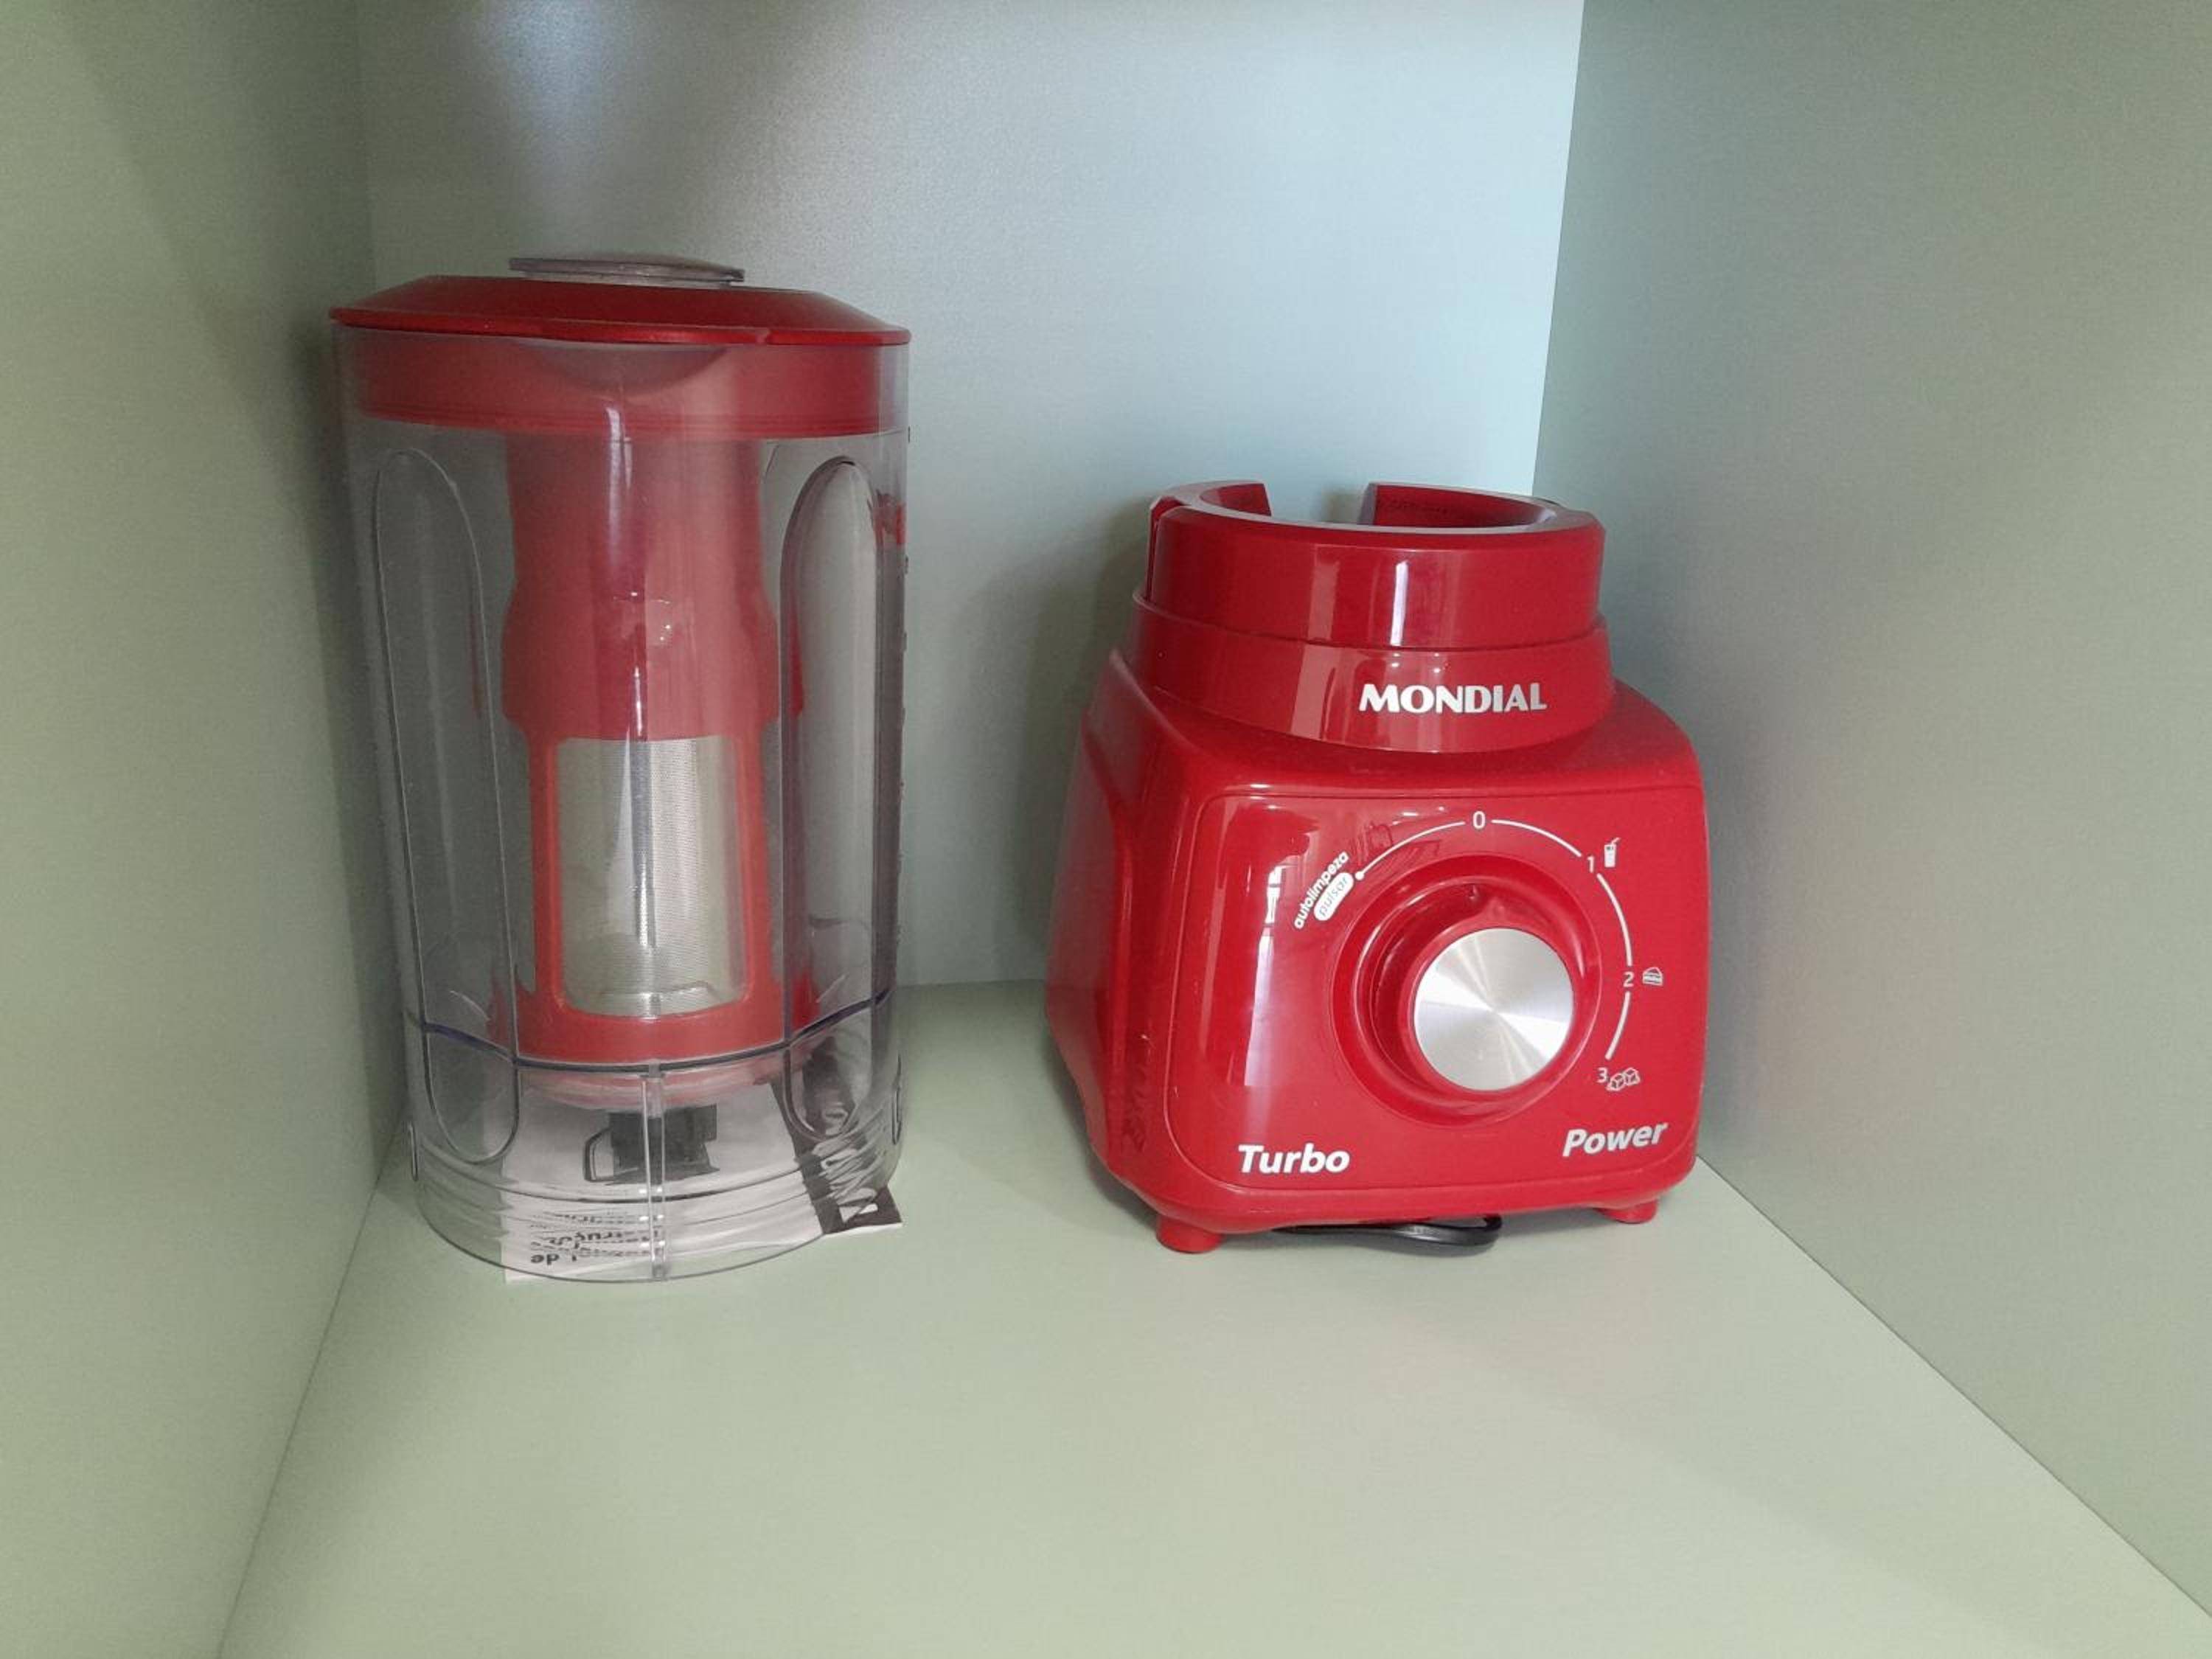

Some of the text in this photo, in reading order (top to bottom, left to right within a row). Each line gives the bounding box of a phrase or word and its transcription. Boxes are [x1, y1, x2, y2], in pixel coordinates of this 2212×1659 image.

[1359, 682, 1547, 714] MONDIAL
[1472, 810, 1486, 830] 0
[1587, 855, 1595, 873] 1
[1294, 851, 1349, 929] autolimpeza
[1318, 875, 1348, 917] pulsar
[1623, 971, 1635, 987] 2
[1596, 1067, 1607, 1083] 3
[1562, 1122, 1669, 1158] Power
[1237, 1142, 1351, 1175] Turbo
